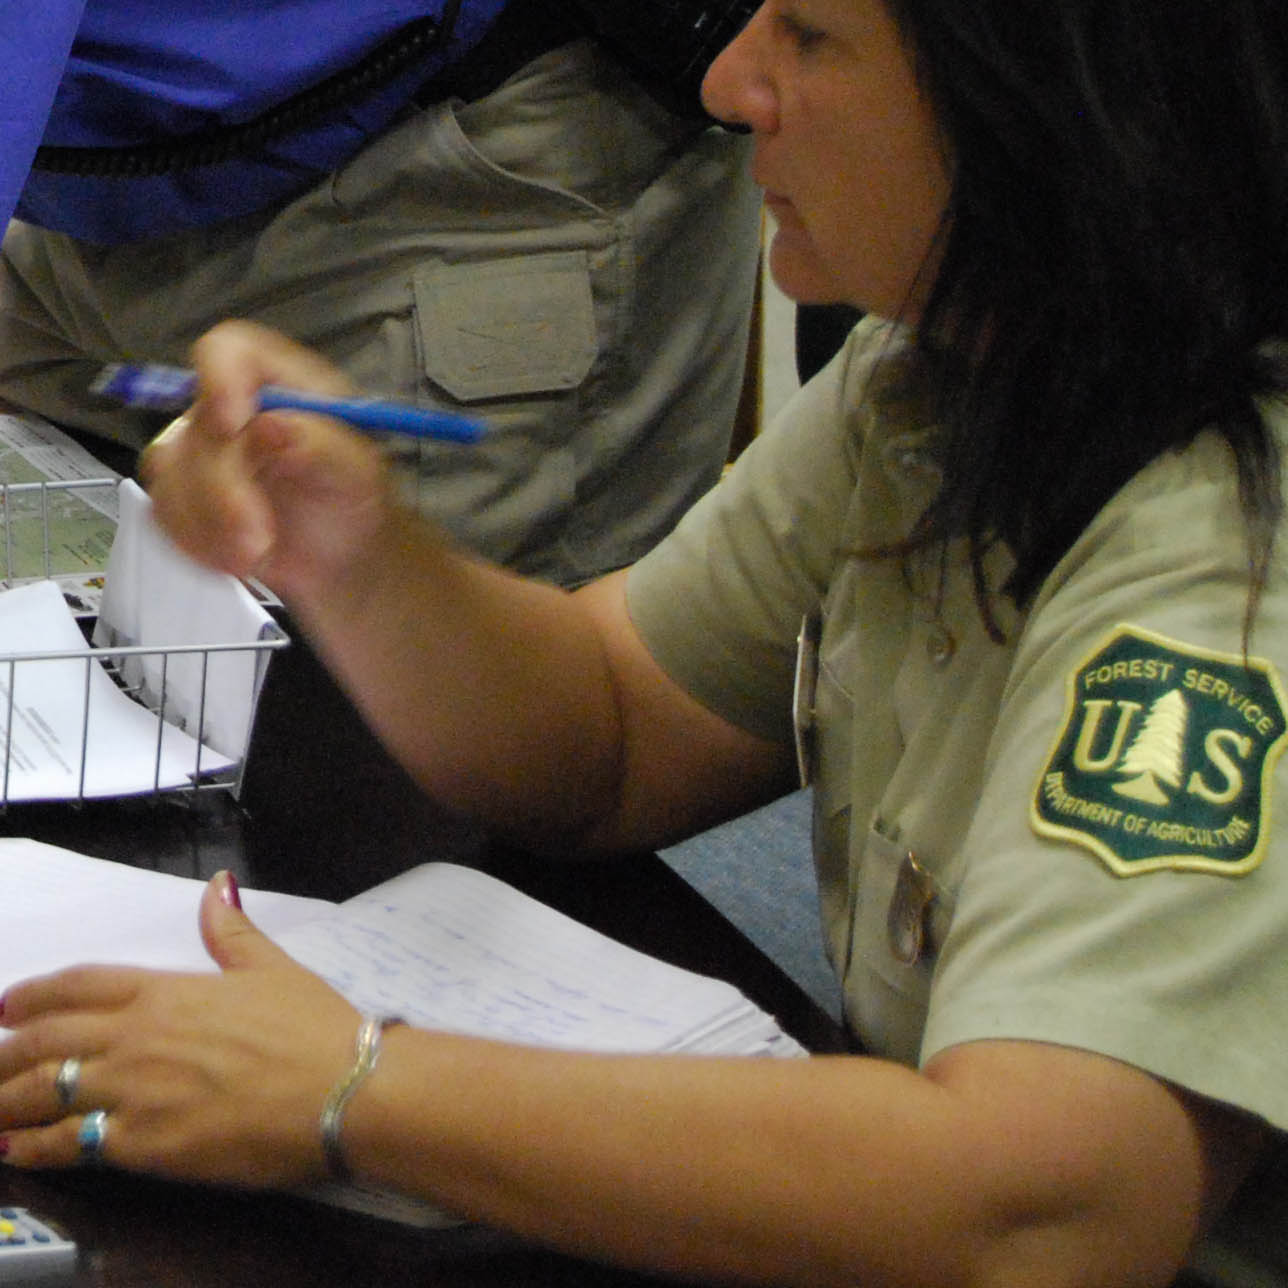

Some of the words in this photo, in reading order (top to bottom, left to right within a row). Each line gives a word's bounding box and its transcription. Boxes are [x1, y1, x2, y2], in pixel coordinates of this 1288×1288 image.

[1084, 659, 1174, 690] FOREST
[1182, 667, 1274, 735] SERVICE
[1123, 814, 1151, 834] OF
